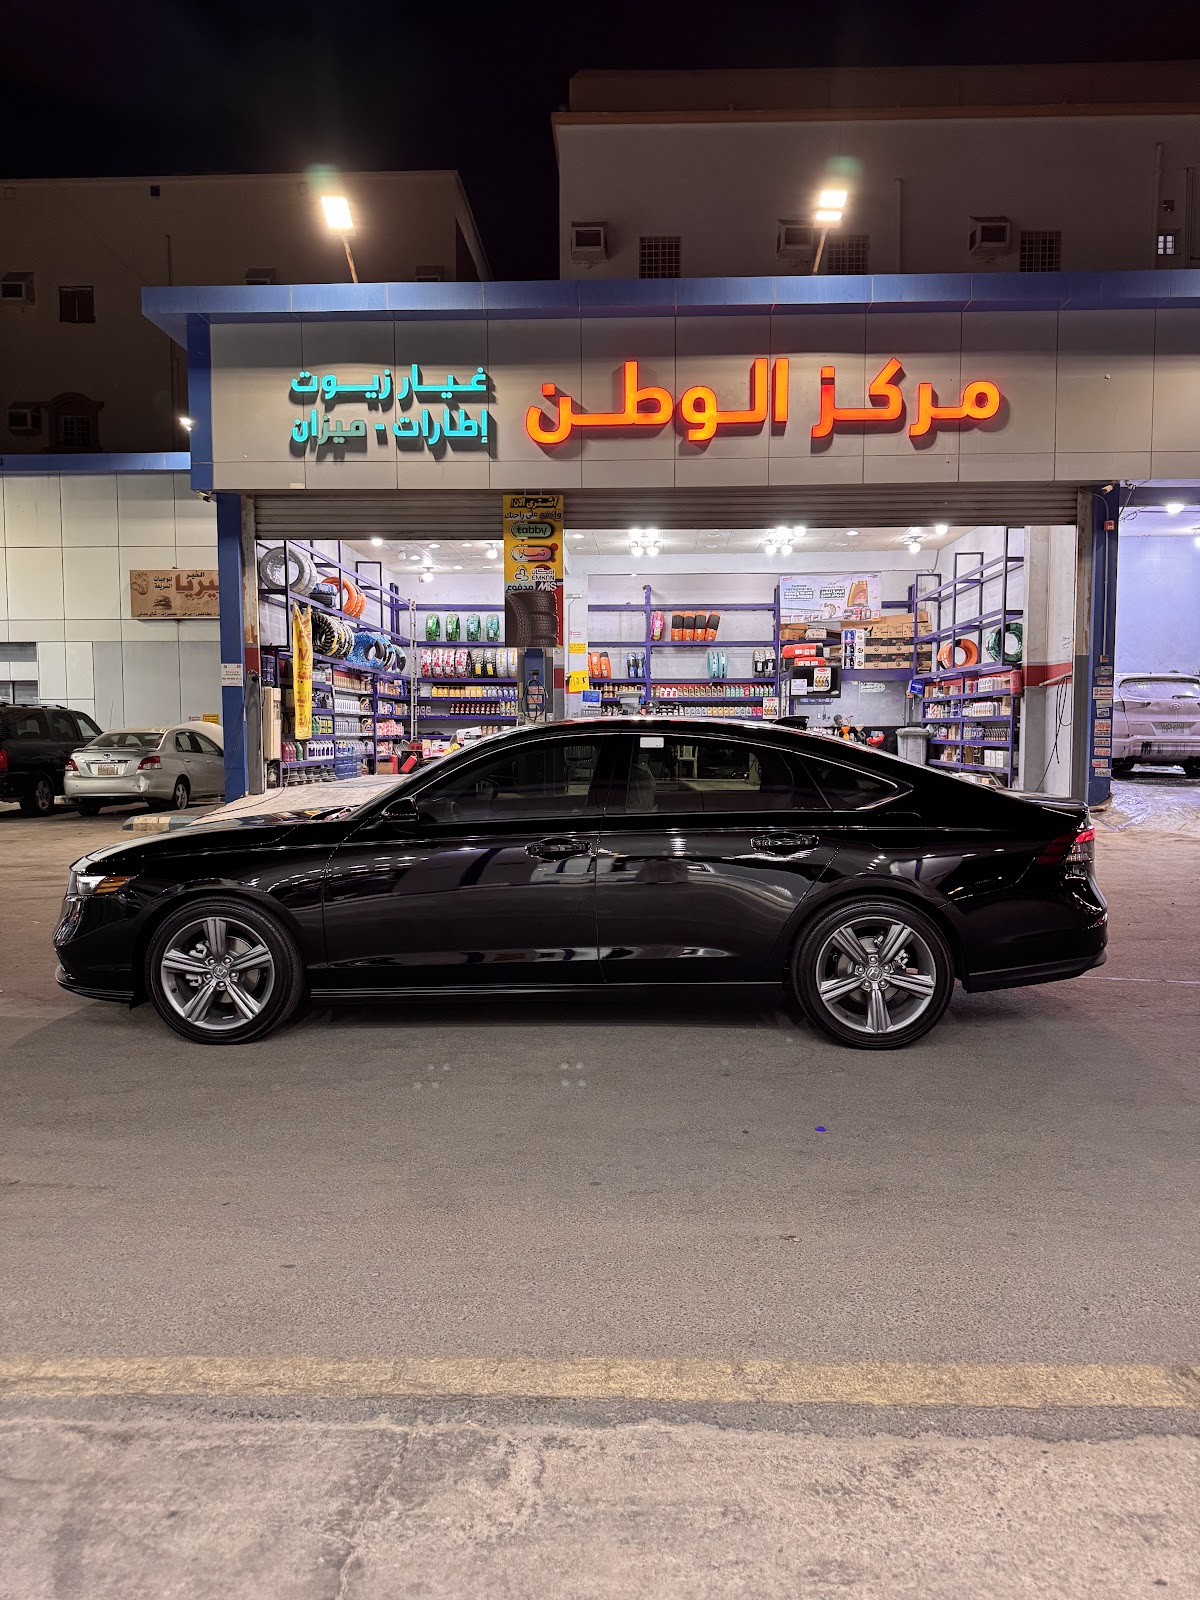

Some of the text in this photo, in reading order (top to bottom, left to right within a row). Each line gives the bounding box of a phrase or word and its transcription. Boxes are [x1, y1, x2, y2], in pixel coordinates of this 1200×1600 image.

[291, 363, 487, 400] غيار زيوت
[525, 357, 1001, 444] مركز الوطن
[291, 409, 367, 445] ميزان
[392, 409, 488, 445] إطارات
[517, 526, 548, 536] tabby
[526, 511, 539, 519] على
[518, 549, 545, 558] تمارا
